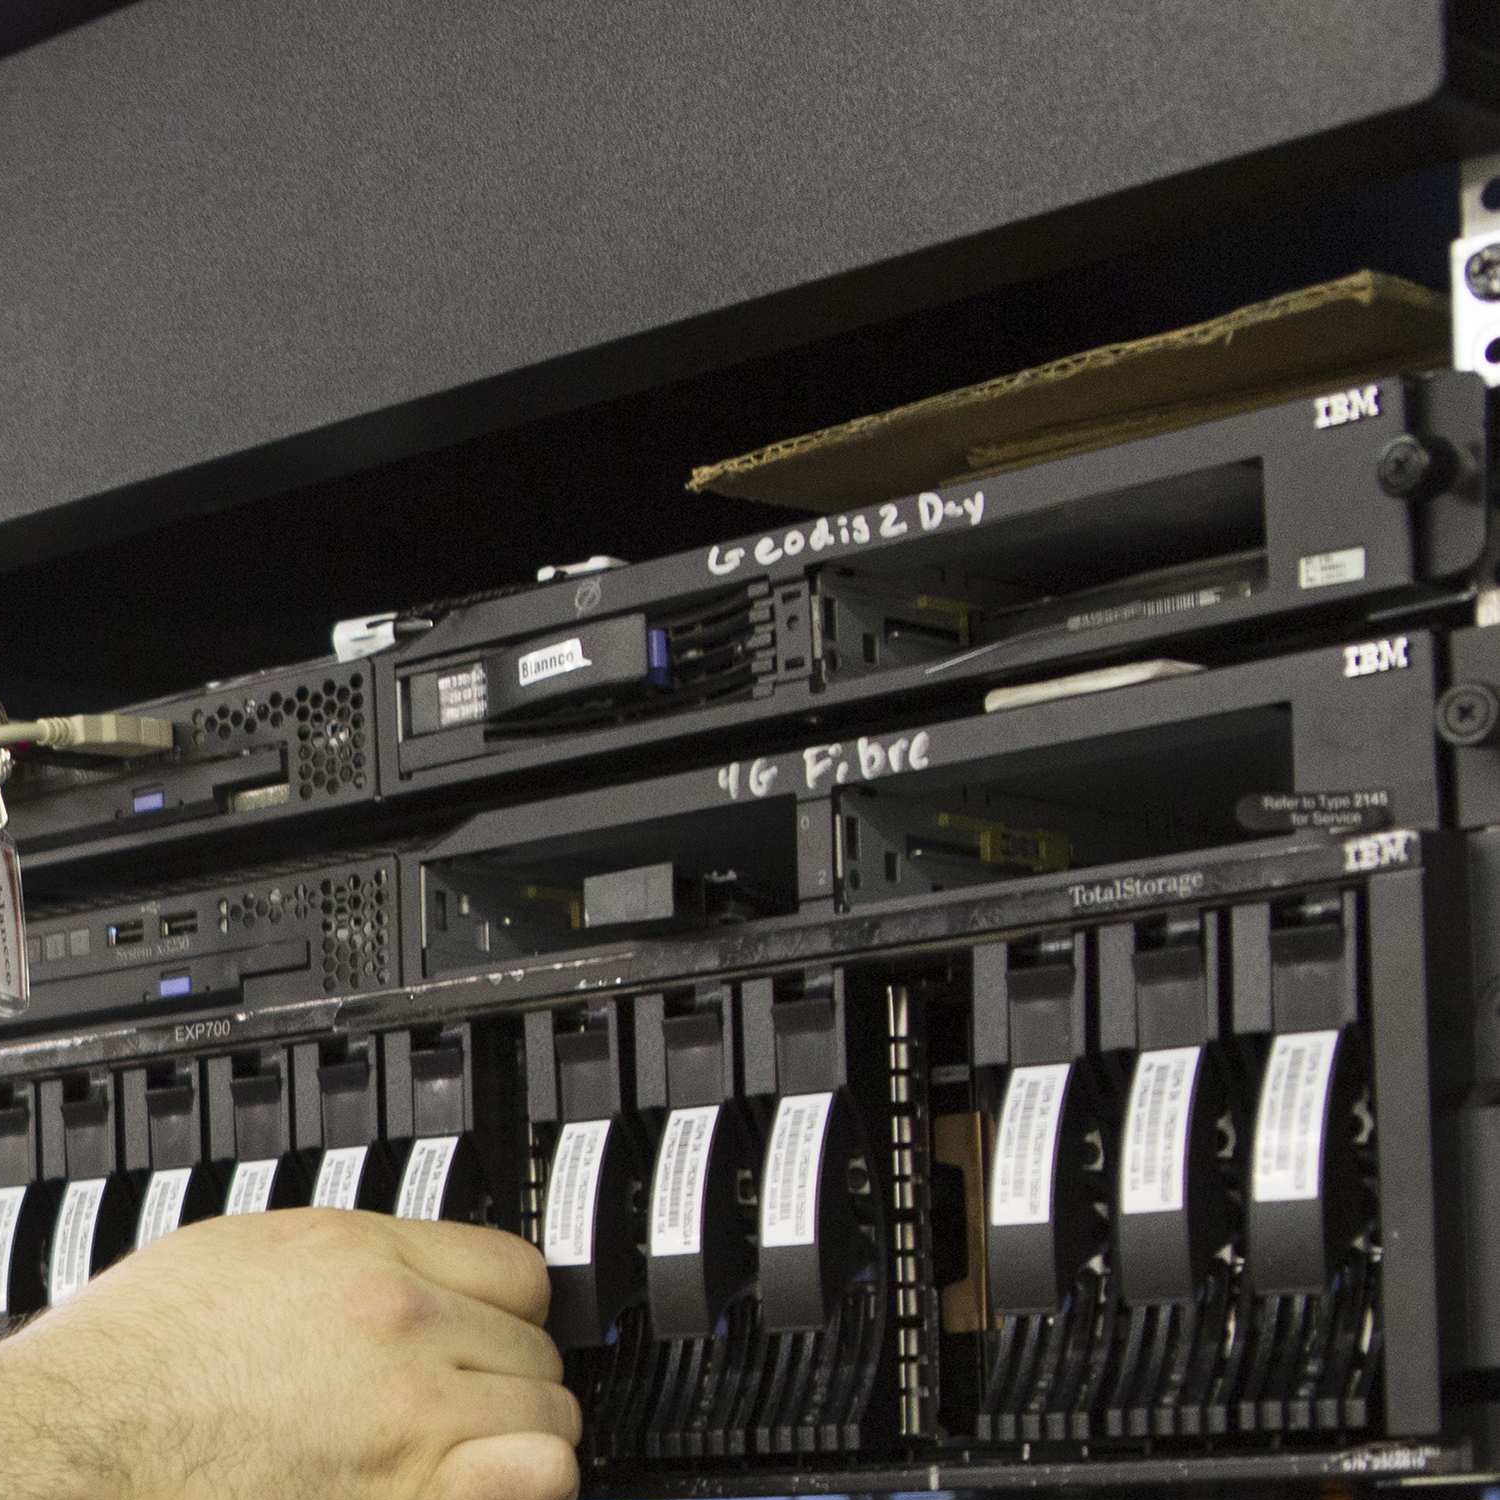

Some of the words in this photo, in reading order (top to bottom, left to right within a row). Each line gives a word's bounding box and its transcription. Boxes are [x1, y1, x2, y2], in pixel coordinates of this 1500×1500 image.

[1314, 385, 1379, 429] IBM
[878, 502, 908, 538] 2
[521, 651, 575, 680] Blannco
[1344, 636, 1409, 678] IBM
[802, 731, 930, 790] Fibre
[1311, 810, 1362, 827] Service
[1344, 829, 1419, 872] IBM
[1067, 870, 1204, 908] TotalStorage
[174, 1019, 232, 1042] EXP700
